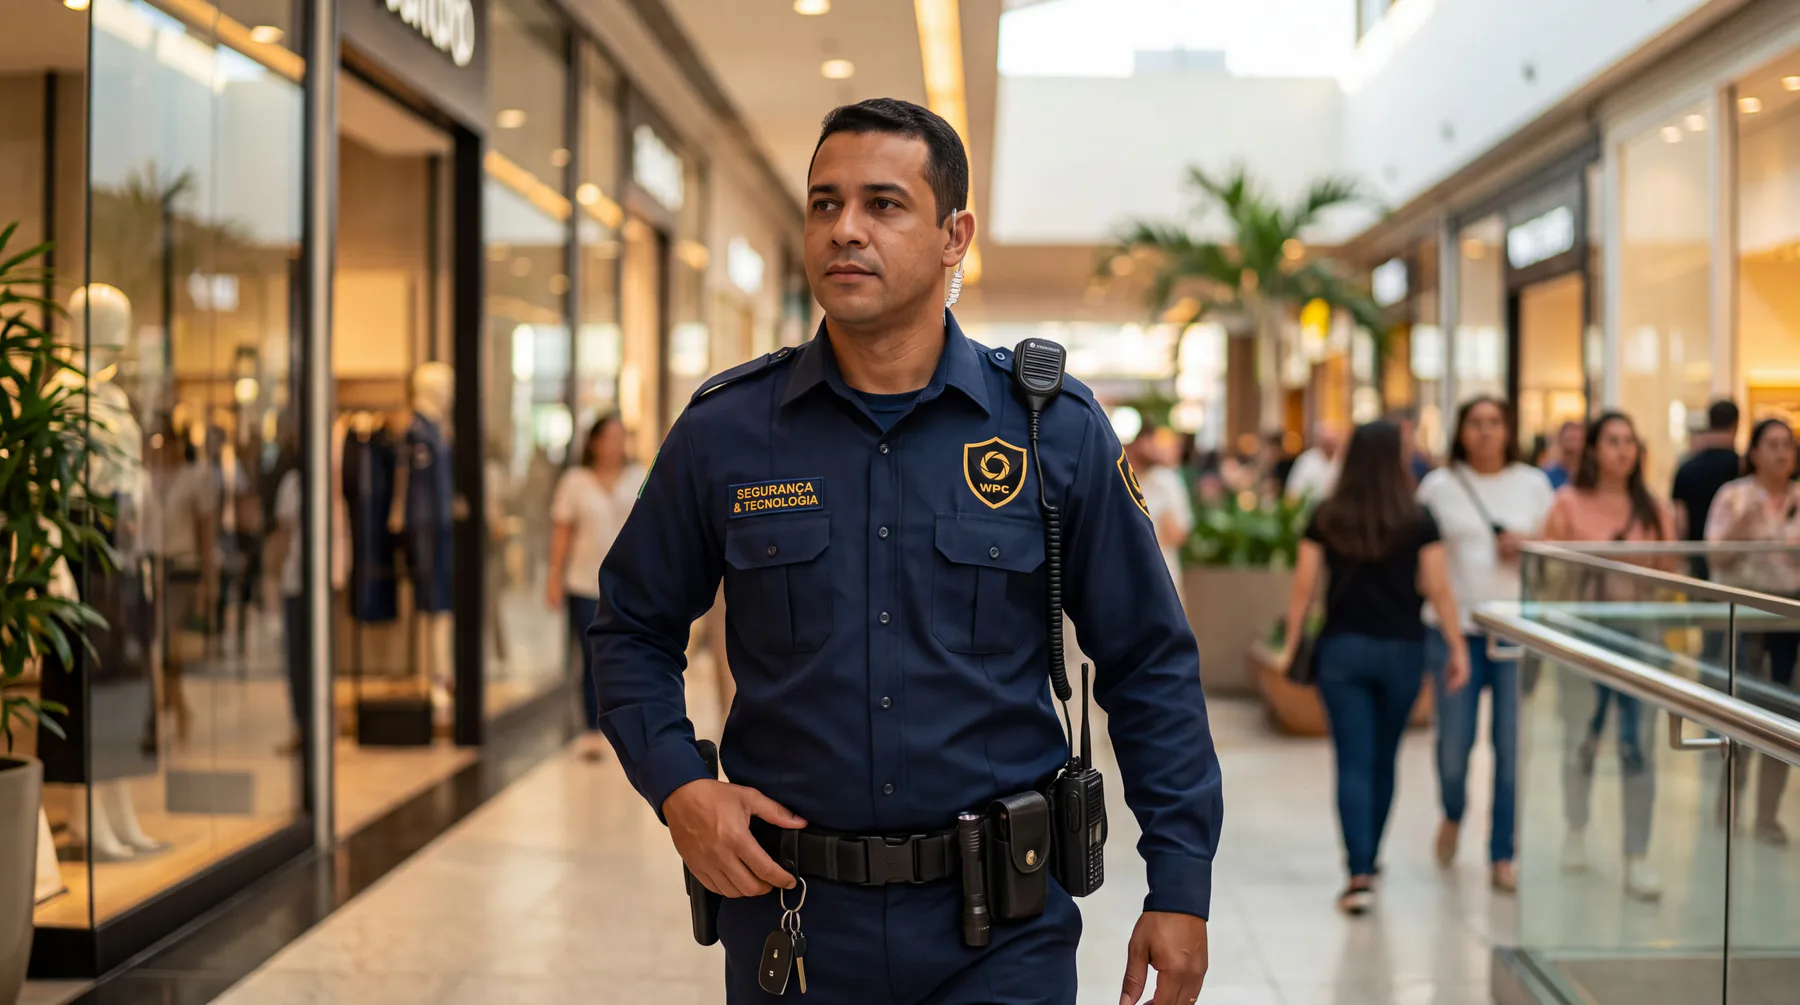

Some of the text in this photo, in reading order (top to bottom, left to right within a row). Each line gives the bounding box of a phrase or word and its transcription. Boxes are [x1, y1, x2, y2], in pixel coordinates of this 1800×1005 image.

[737, 482, 814, 500] SEGURANÇA
[979, 483, 1010, 494] WPC
[733, 495, 819, 513] & TECNOLOGIA
